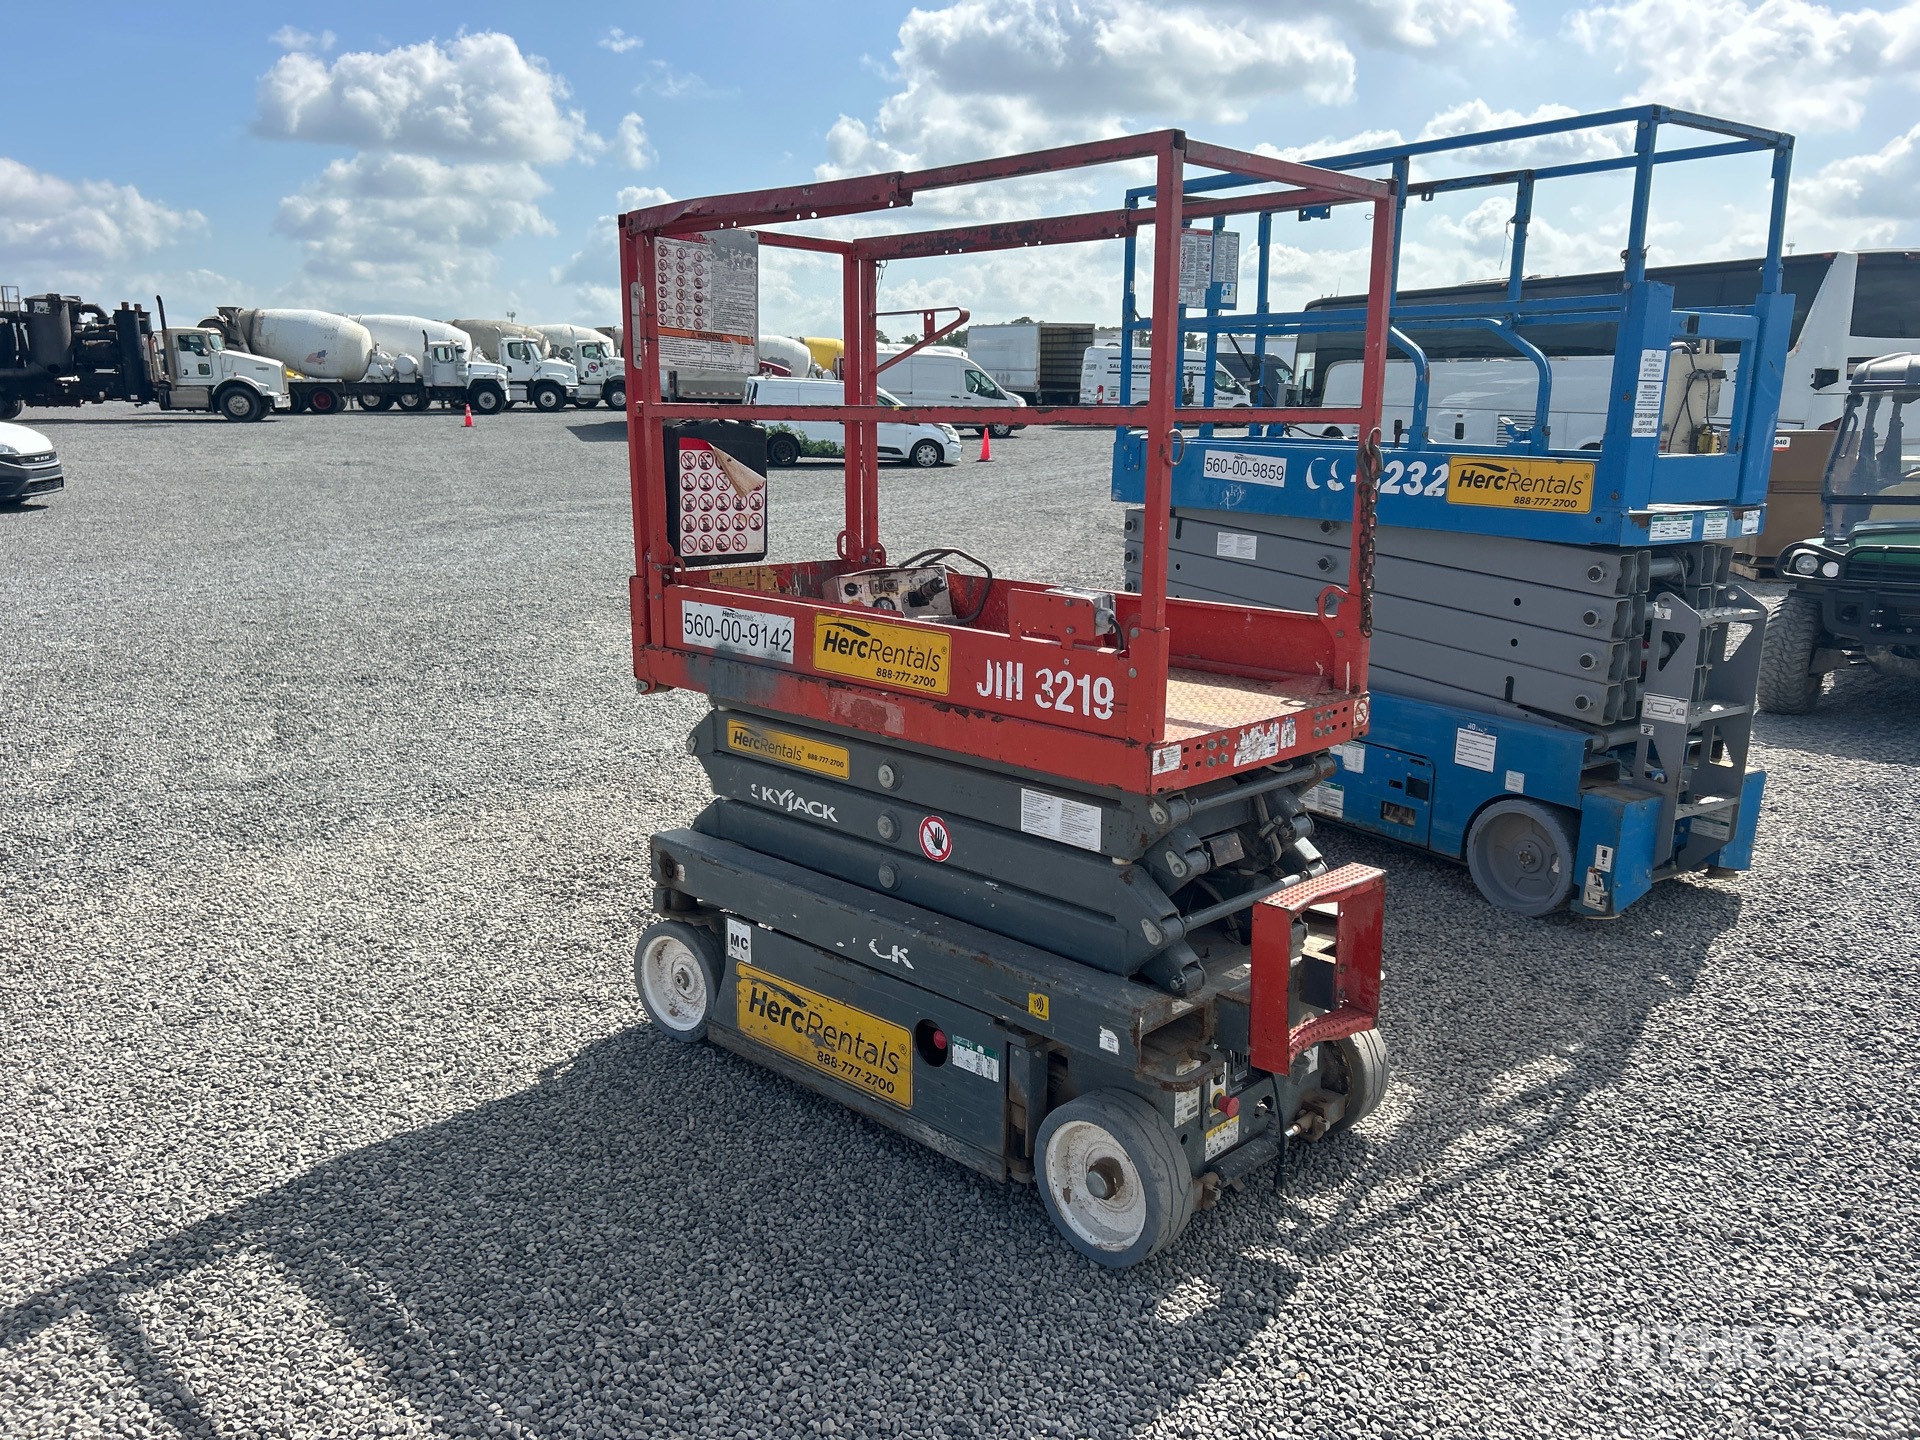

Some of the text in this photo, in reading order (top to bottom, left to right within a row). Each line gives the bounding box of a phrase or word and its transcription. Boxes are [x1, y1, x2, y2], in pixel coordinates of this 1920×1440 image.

[34, 306, 50, 314] ACE
[697, 333, 724, 342] WARNING
[1205, 457, 1284, 481] 560-00-9859
[1457, 469, 1584, 495] HercRentals
[1513, 496, 1577, 509] 888-777-2700
[722, 610, 754, 621] HercRentals
[684, 612, 792, 654] 560-00-9142
[822, 629, 942, 673] HercRentals
[875, 666, 937, 688] 888-777-2700
[1034, 667, 1115, 721] 3219
[733, 730, 845, 769] HercRentals 888-777-2700
[730, 932, 749, 950] MC
[748, 986, 901, 1076] HercRentals
[816, 1050, 895, 1095] 888-777-2700
